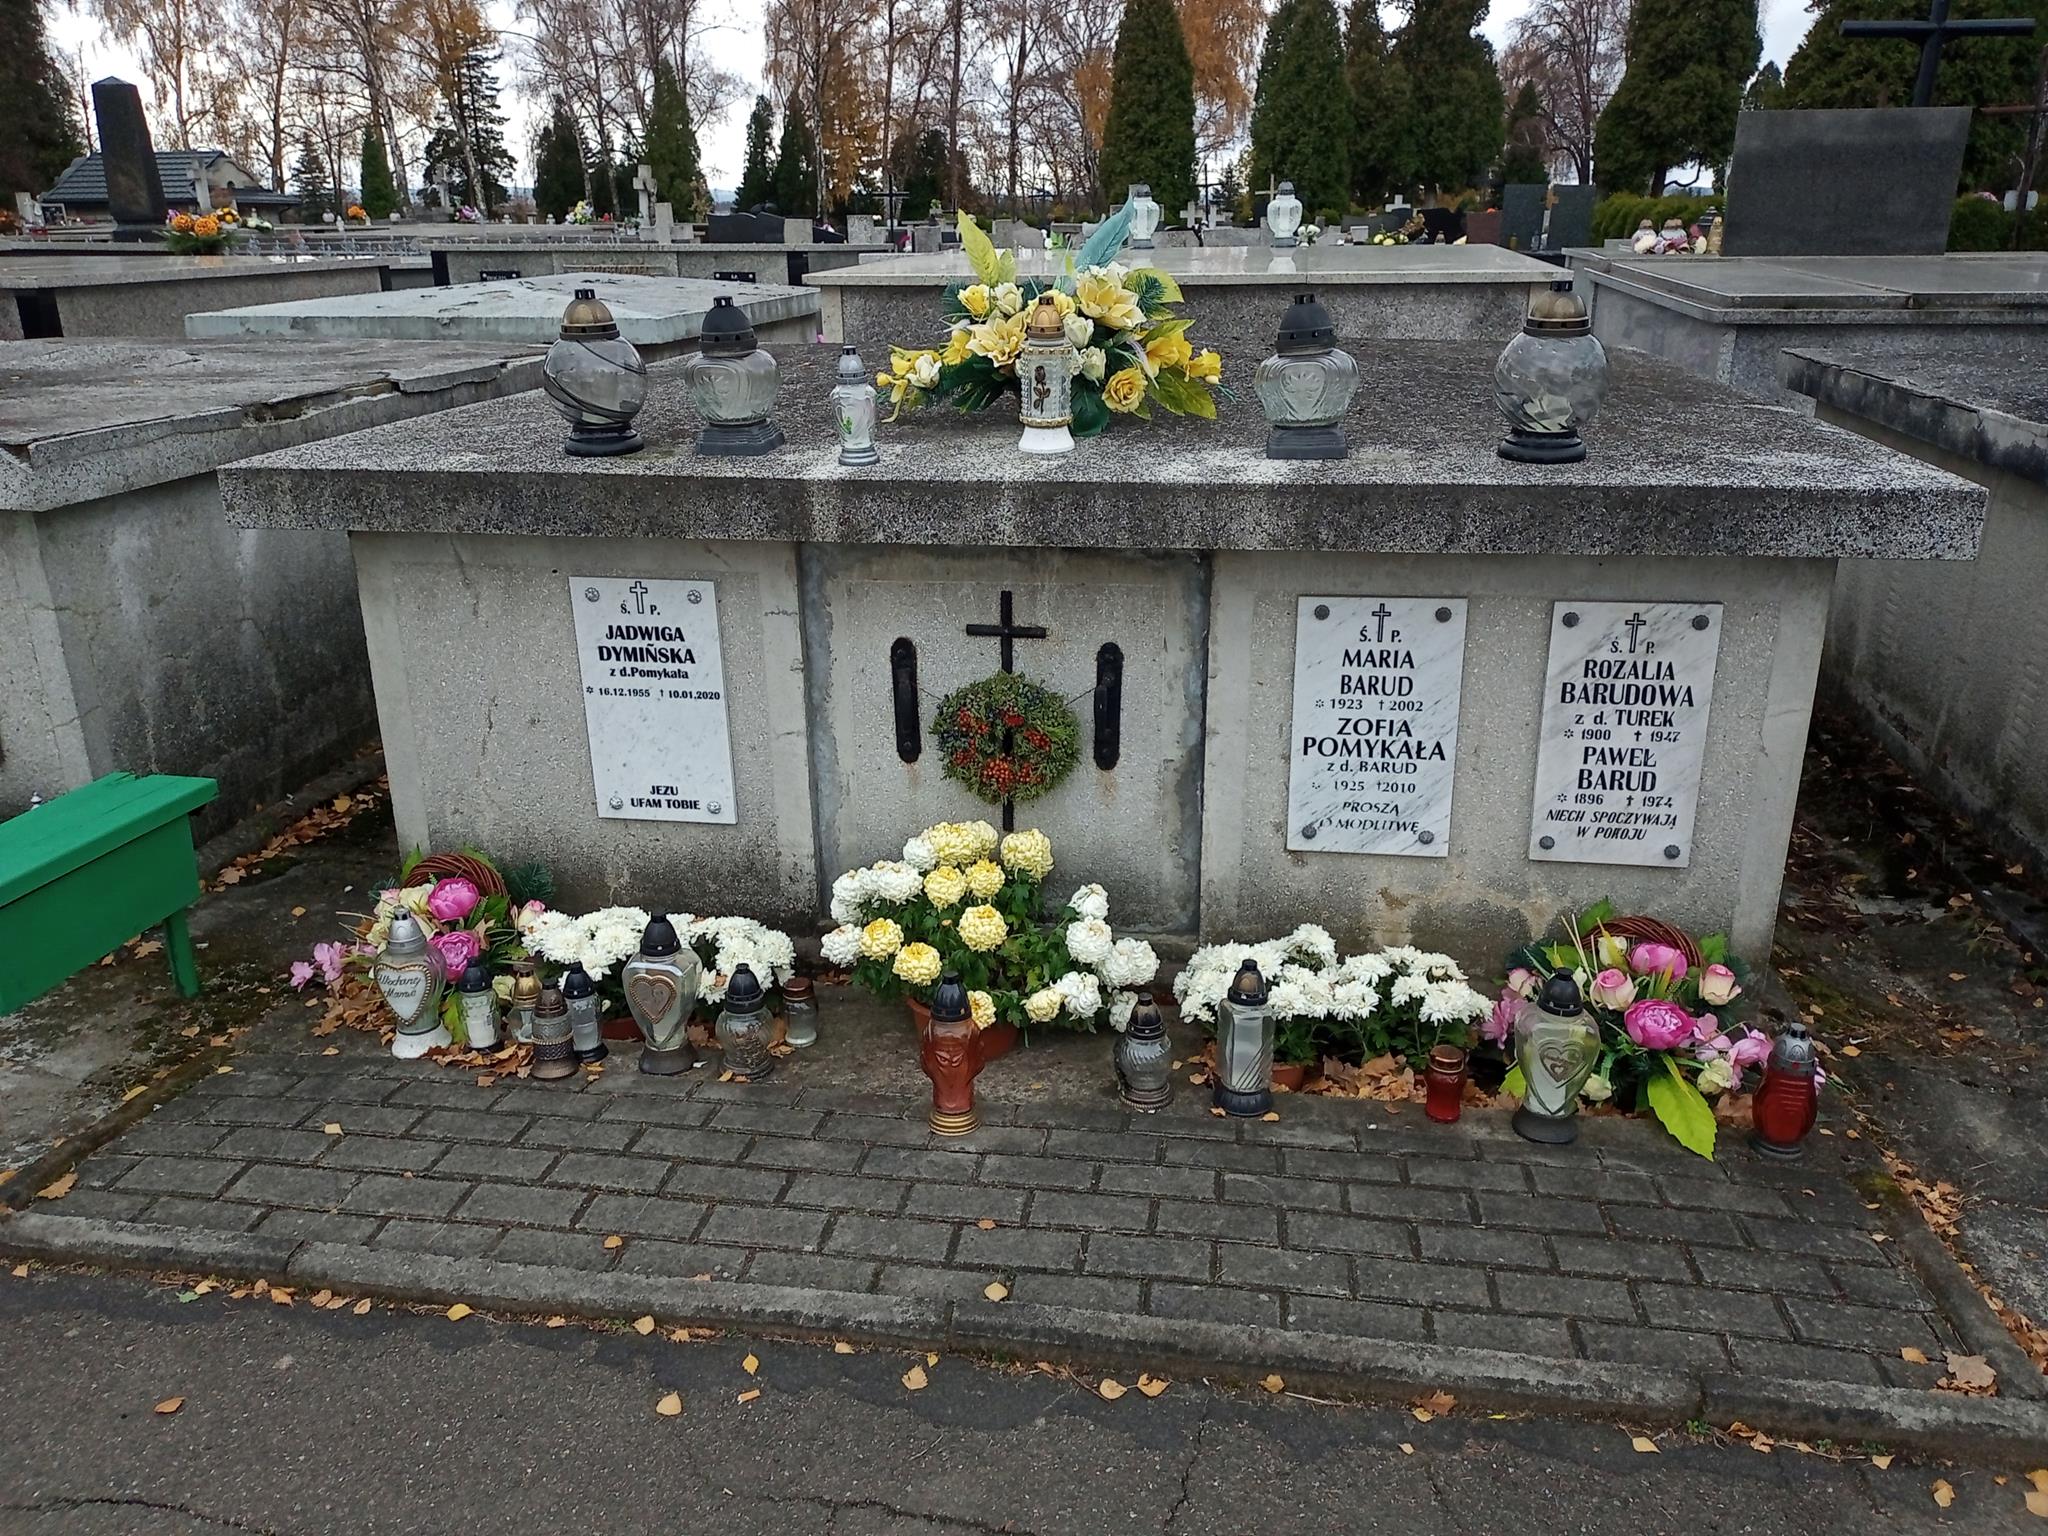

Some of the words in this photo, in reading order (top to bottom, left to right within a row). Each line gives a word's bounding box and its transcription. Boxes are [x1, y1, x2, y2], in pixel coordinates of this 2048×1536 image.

[650, 604, 661, 616] P.
[605, 625, 685, 642] JADWIGA
[1359, 625, 1372, 642] Ś.
[1391, 630, 1402, 643] P.
[1610, 636, 1622, 654] Ś.
[1645, 641, 1655, 654] P.
[1342, 649, 1415, 669] MARIA
[610, 668, 617, 677] z
[1583, 659, 1675, 681] ROZALIA
[599, 688, 650, 698] 16.12.1955
[668, 690, 720, 700] 10.01.2020
[1340, 674, 1414, 697] BARUD
[1560, 682, 1694, 707] BARUDOWA
[1330, 698, 1363, 710] 1923
[1389, 700, 1424, 712] 2002
[1575, 714, 1584, 725] z
[1593, 711, 1607, 725] d.
[1615, 709, 1675, 727] TUREK
[1337, 717, 1413, 738] ZOFIA
[1581, 729, 1611, 741] 1900
[1650, 730, 1680, 743] 1947
[1303, 736, 1446, 761] POMYKAŁA
[1583, 746, 1657, 767] PAWEŁ
[1327, 762, 1334, 772] z
[1340, 760, 1353, 772] d.
[1359, 761, 1418, 774] BARUD
[1334, 780, 1365, 791] 1925
[1382, 782, 1416, 793] 2010
[1577, 768, 1657, 792] BARUD
[650, 786, 679, 796] JEZU
[631, 798, 662, 809] UFAM
[665, 799, 701, 810] TOBIE
[1574, 793, 1604, 805] 1896
[1642, 796, 1674, 808] 1974
[1546, 809, 1586, 822] NIECH
[1590, 811, 1678, 830] SPOCZYWAJĄ
[1577, 826, 1592, 838] W
[1594, 827, 1648, 840] POKOJU
